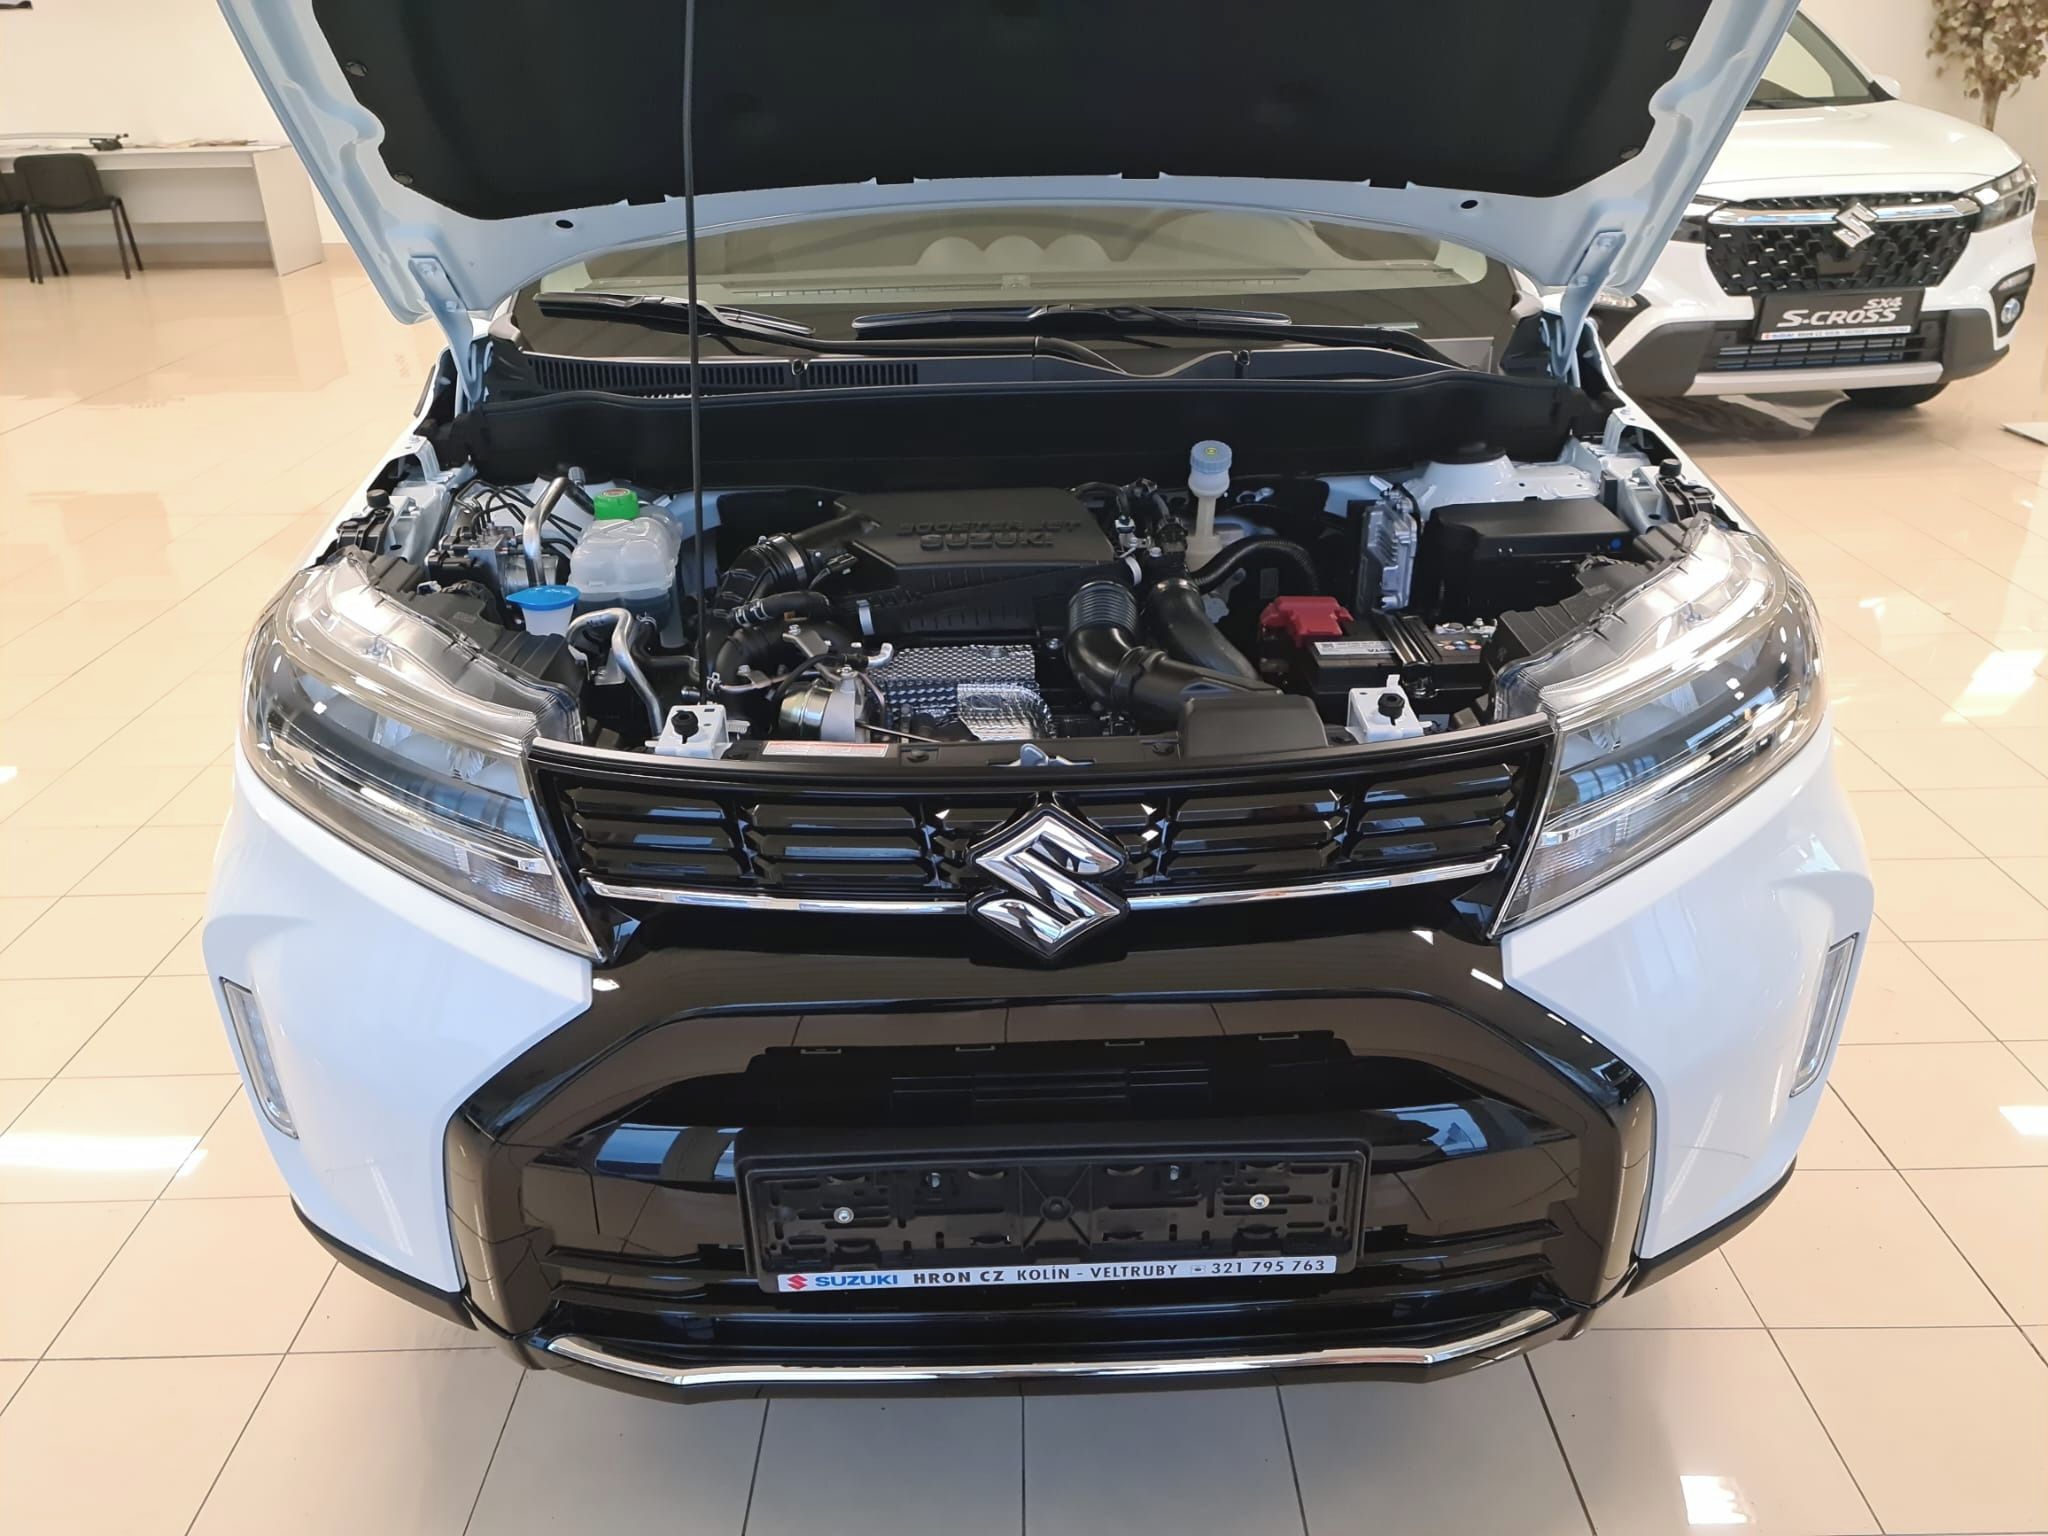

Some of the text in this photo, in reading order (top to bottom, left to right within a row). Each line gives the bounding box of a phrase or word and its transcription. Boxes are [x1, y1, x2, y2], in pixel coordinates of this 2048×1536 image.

[1862, 296, 1903, 310] SX4
[1776, 307, 1901, 328] S-CROSS
[920, 532, 1055, 551] SUZUKI
[815, 1274, 898, 1288] SUZUKI
[913, 1271, 971, 1285] HRON
[980, 1270, 1004, 1283] CZ
[1017, 1265, 1070, 1281] KOLÍN
[1090, 1264, 1178, 1279] VELTRUBY
[1211, 1262, 1243, 1274] 321
[1251, 1261, 1284, 1273] 795
[1292, 1259, 1325, 1272] 763
